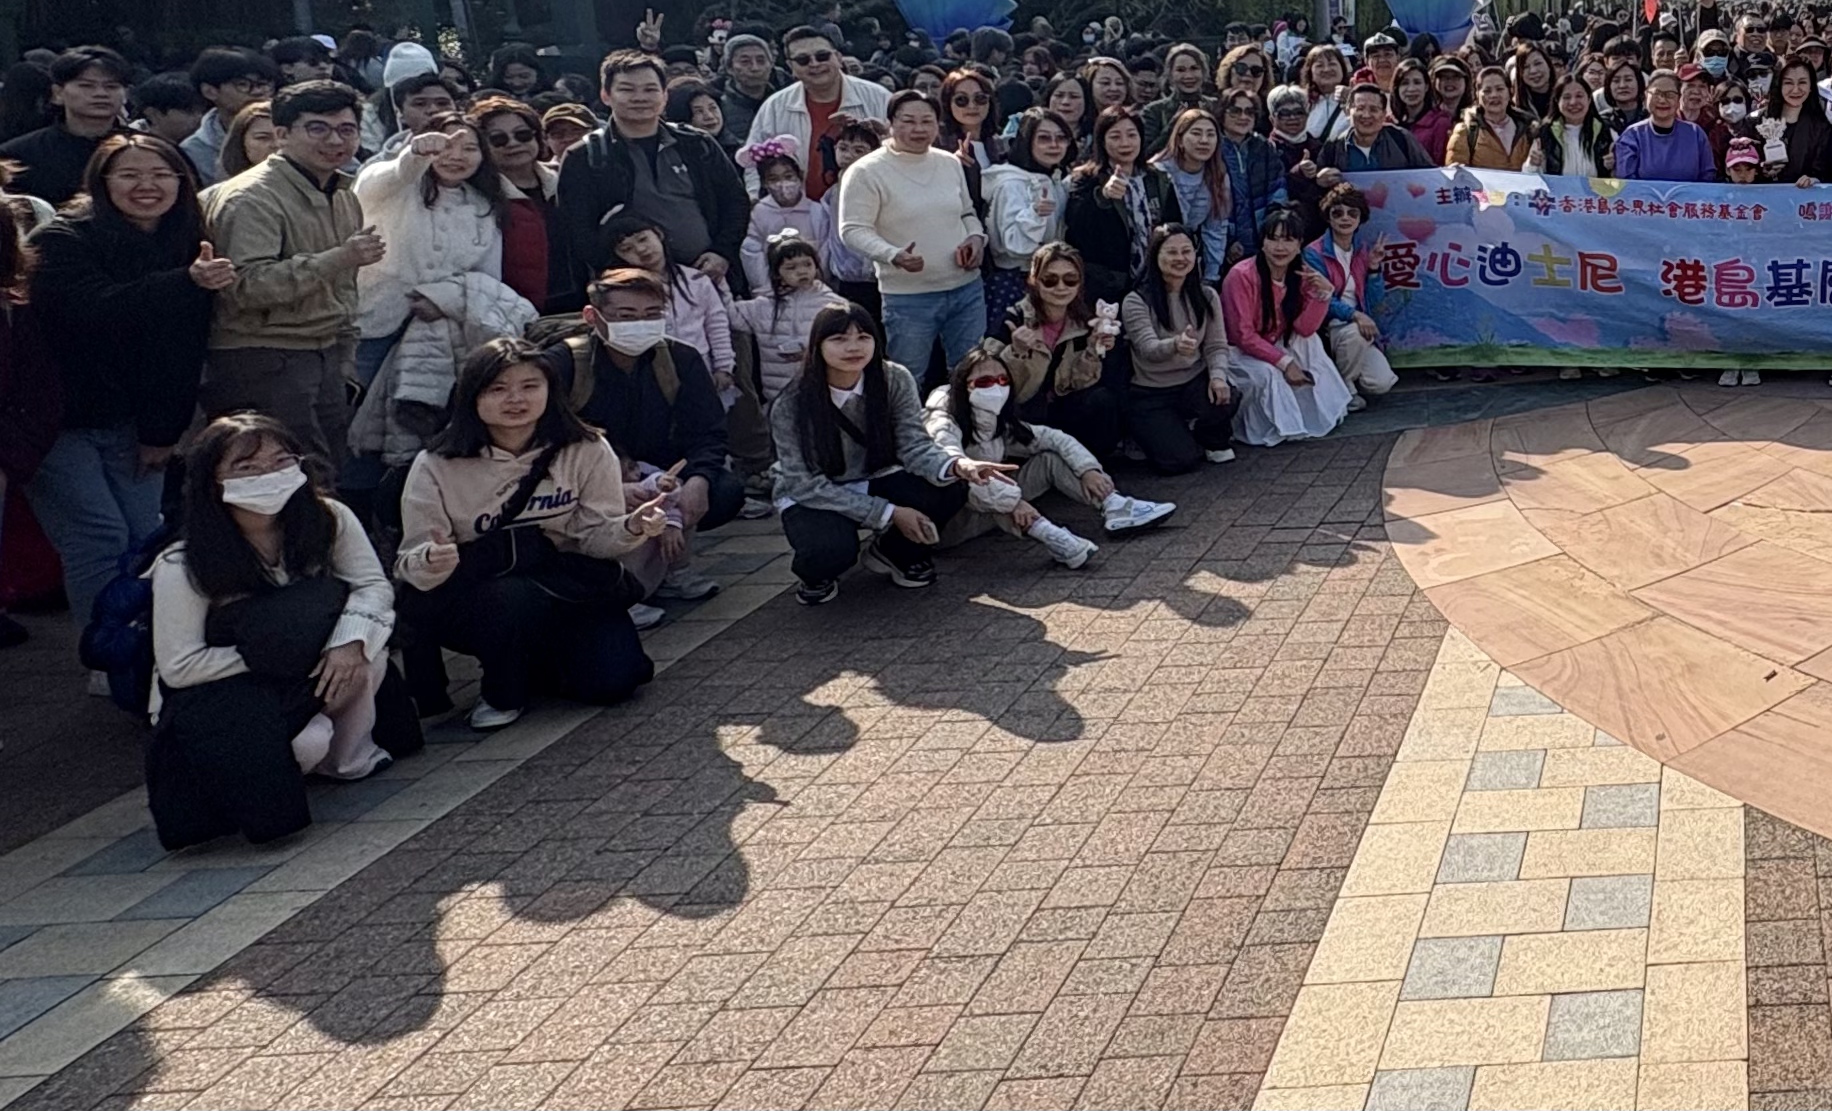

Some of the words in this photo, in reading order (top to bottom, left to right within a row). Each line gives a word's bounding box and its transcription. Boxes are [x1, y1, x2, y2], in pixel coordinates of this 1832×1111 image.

[1382, 241, 1625, 294] 愛心迪士尼
